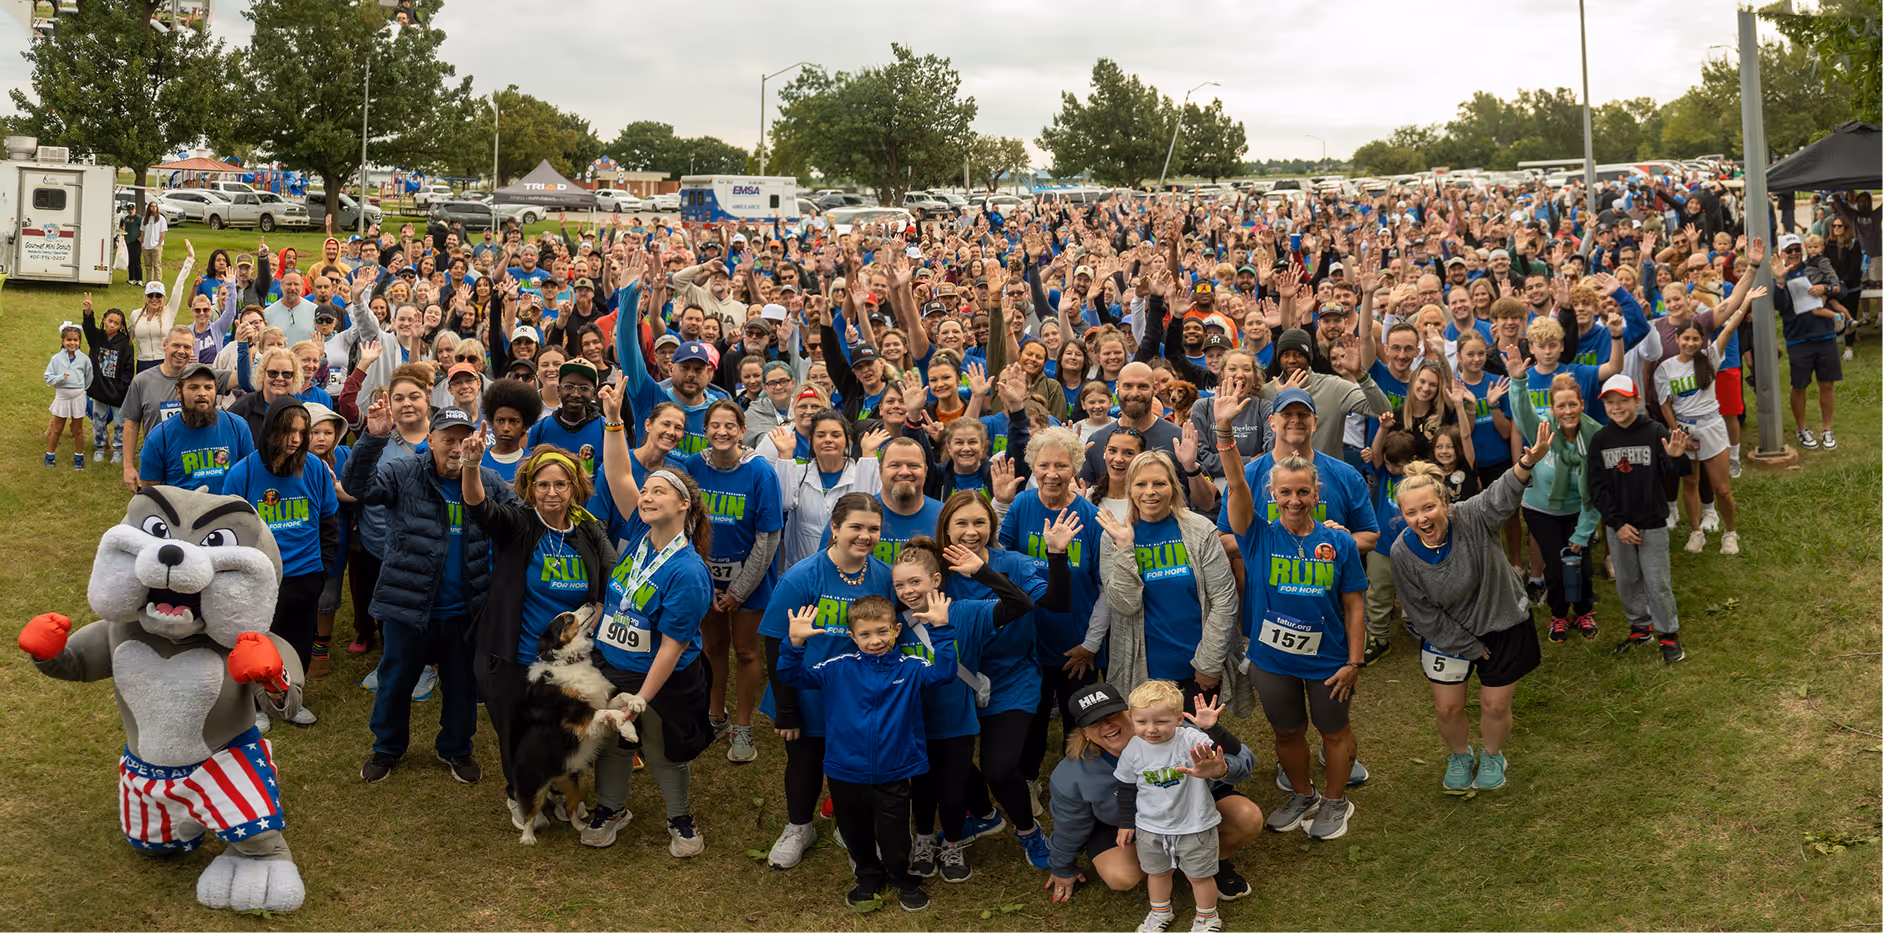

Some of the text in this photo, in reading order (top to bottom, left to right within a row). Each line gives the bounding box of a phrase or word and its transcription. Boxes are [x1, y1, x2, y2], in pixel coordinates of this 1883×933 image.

[732, 186, 760, 195] EMSA
[25, 242, 45, 250] Gourmet
[56, 243, 72, 251] Donuts
[1601, 446, 1650, 470] KNIGHTS
[257, 499, 310, 525] RUN
[283, 520, 302, 528] HOPE
[712, 566, 732, 578] 37
[1164, 567, 1187, 576] HOPE
[1269, 556, 1334, 591] RUN
[1299, 587, 1324, 595] HOPE
[1276, 616, 1312, 632] tatur.org
[606, 622, 640, 648] 909
[1272, 628, 1310, 650] 157
[1433, 656, 1446, 672] 5
[1078, 690, 1110, 710] HIA
[150, 768, 166, 778] IS
